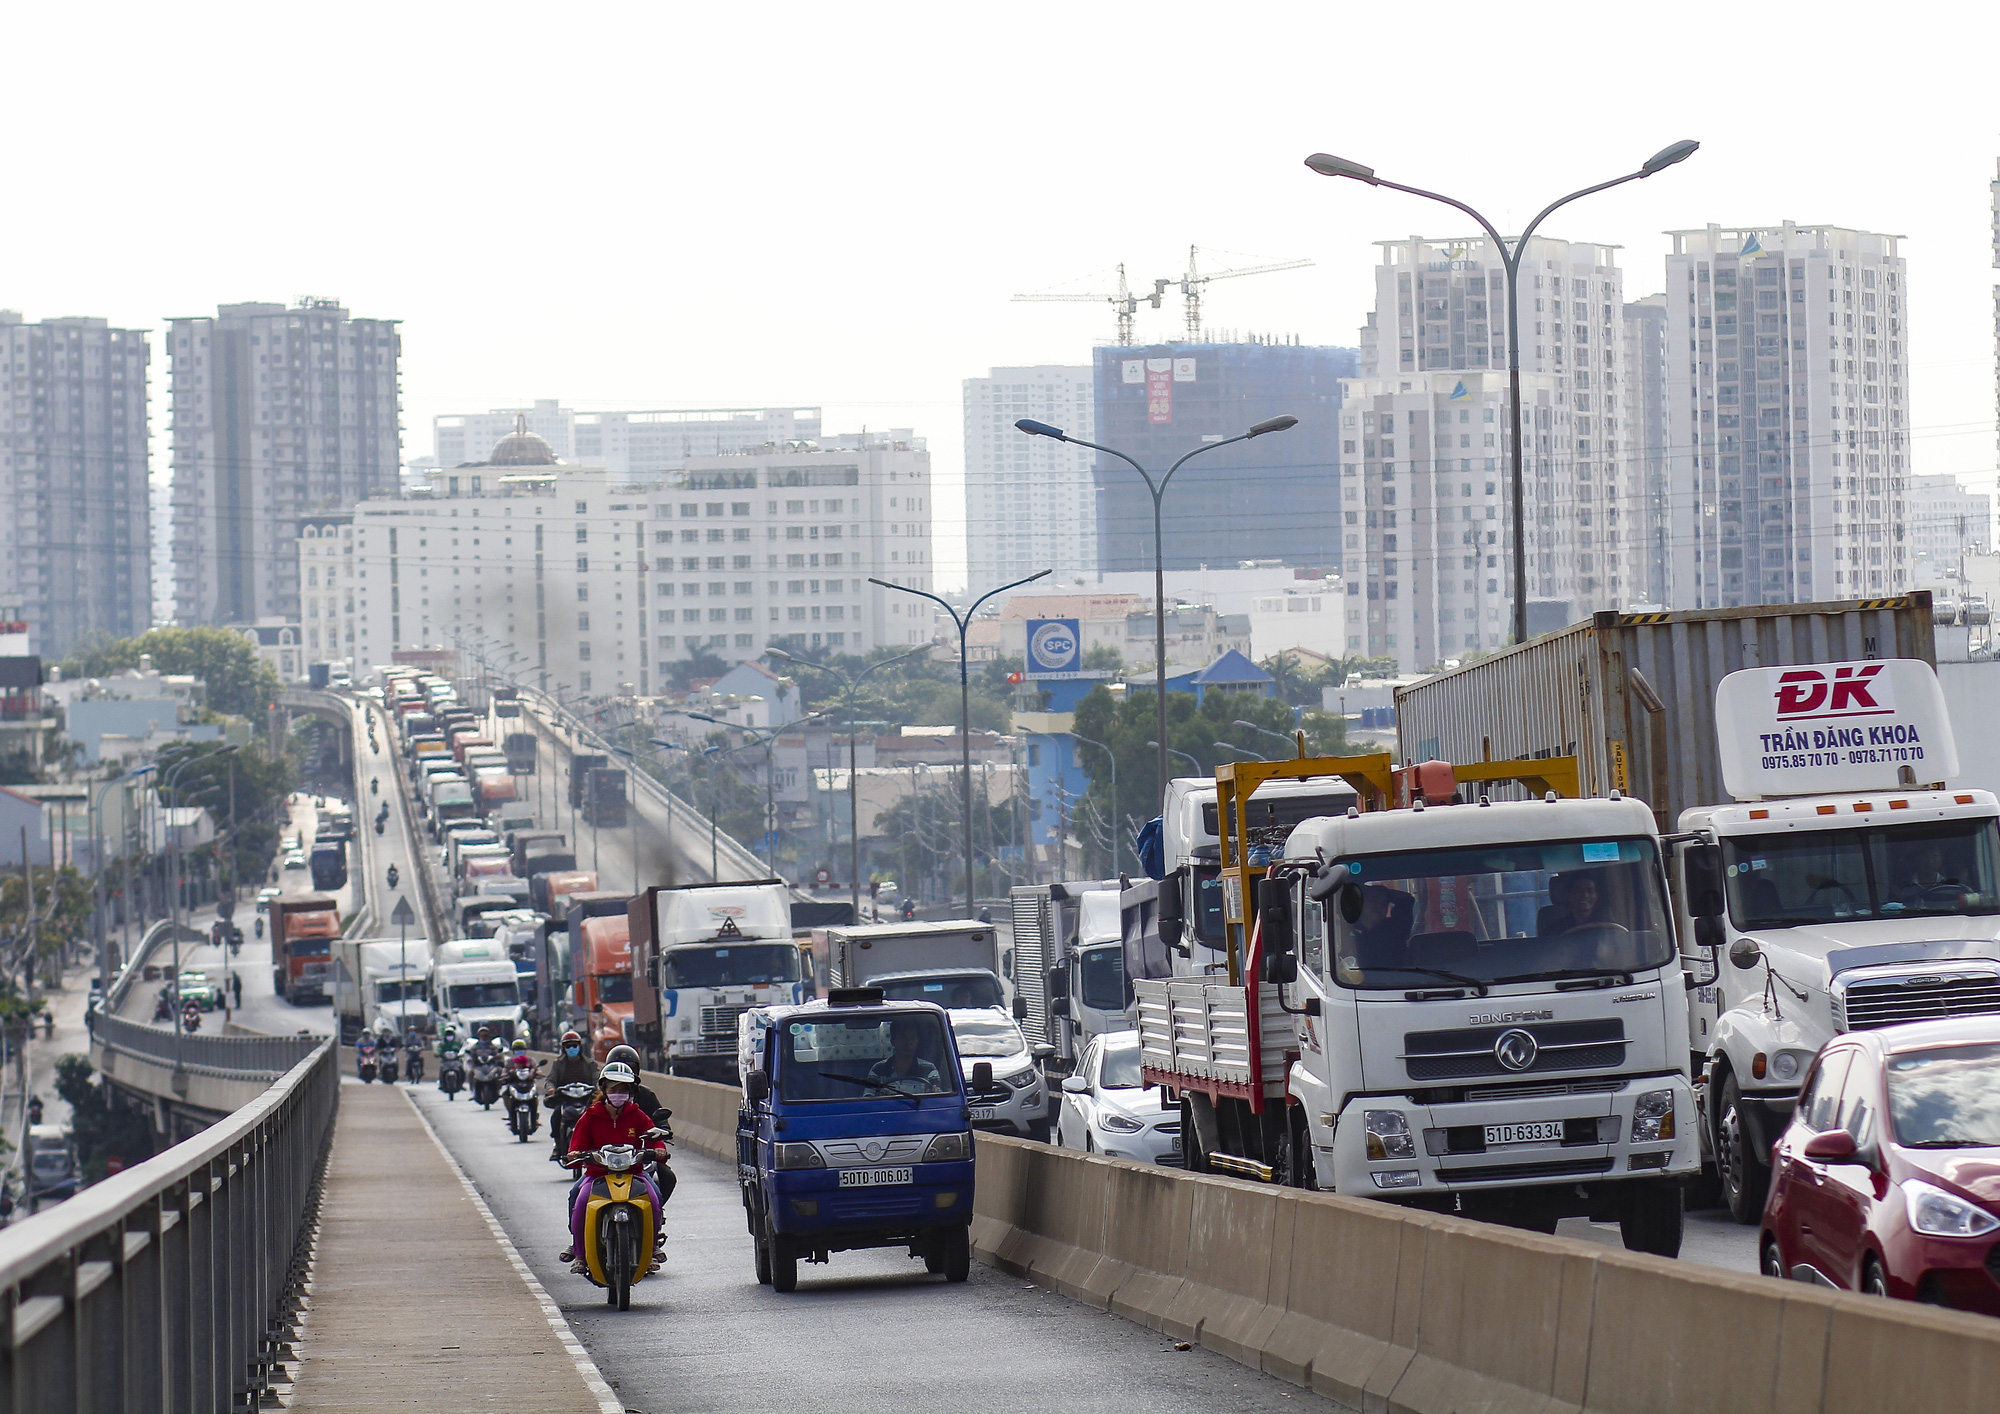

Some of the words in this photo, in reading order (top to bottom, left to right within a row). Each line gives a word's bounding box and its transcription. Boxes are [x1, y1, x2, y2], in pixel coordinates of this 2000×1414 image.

[1046, 640, 1071, 650] SPC
[1773, 664, 1886, 715] ĐK
[1760, 725, 1809, 753] TRẦN
[1813, 725, 1865, 750] ĐĂNG
[1868, 724, 1920, 746] KHOA
[1469, 1009, 1554, 1025] DONGFENG
[1486, 1123, 1562, 1143] 51D-633.34
[842, 1169, 910, 1185] 50TD-006.03
